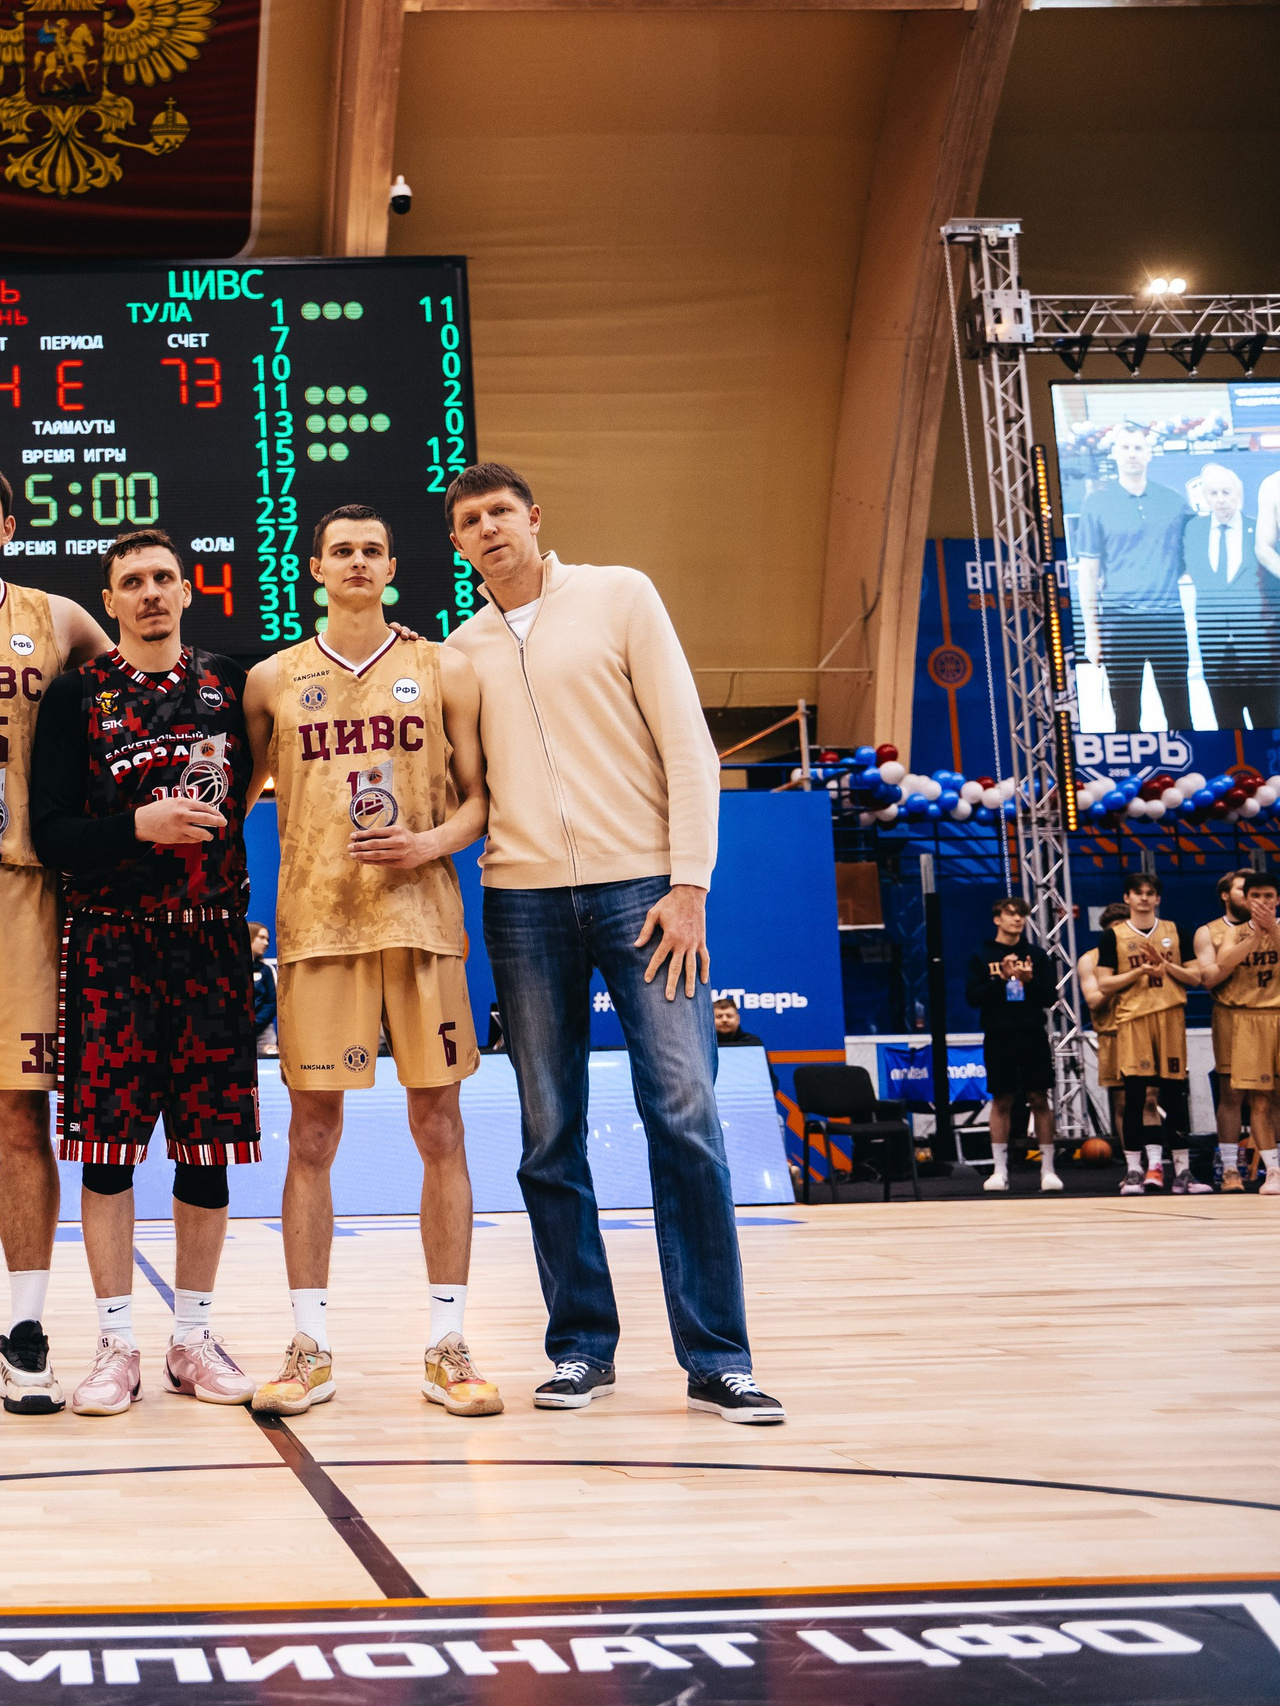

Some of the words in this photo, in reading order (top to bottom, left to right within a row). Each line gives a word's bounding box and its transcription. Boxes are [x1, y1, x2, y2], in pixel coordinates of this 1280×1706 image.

[169, 269, 264, 300] ЦИВС
[126, 299, 192, 323] ТУЛА
[271, 298, 283, 324] 1
[420, 296, 453, 322] 11
[40, 335, 103, 350] ПЕРИОД
[168, 334, 209, 348] СЧЕТ
[270, 326, 290, 353] 7
[441, 324, 459, 350] 0
[252, 354, 290, 381] 10
[442, 352, 460, 378] 0
[161, 358, 222, 408] 73
[253, 382, 287, 409] 11
[444, 380, 463, 407] 2
[32, 420, 115, 435] ТАЙМАУТЫ
[254, 411, 293, 438] 13
[446, 408, 464, 435] 0
[22, 449, 74, 463] ВРЕМЯ
[84, 448, 126, 462] ИГРЫ
[256, 439, 294, 466] 15
[427, 436, 466, 463] 12
[257, 467, 296, 495] 17
[26, 472, 159, 526] 5:00
[256, 496, 297, 524] 23
[4, 539, 57, 557] ВРЕМЯ
[65, 539, 115, 556] ПЕРЕ
[191, 537, 234, 552] ФОЛЫ
[257, 525, 298, 553] 27
[259, 554, 299, 582] 28
[195, 564, 233, 616] 4
[260, 583, 296, 611] 31
[455, 580, 474, 608] 8
[261, 612, 302, 641] 35
[12, 640, 32, 649] РФБ
[395, 686, 417, 694] РФБ
[101, 719, 123, 731] STK
[298, 715, 424, 761] ЦИВС
[1074, 732, 1188, 766] ВЕРЬ
[20, 1032, 58, 1074] 35
[947, 1063, 987, 1079] molte
[795, 1619, 1204, 1668] ЦФО
